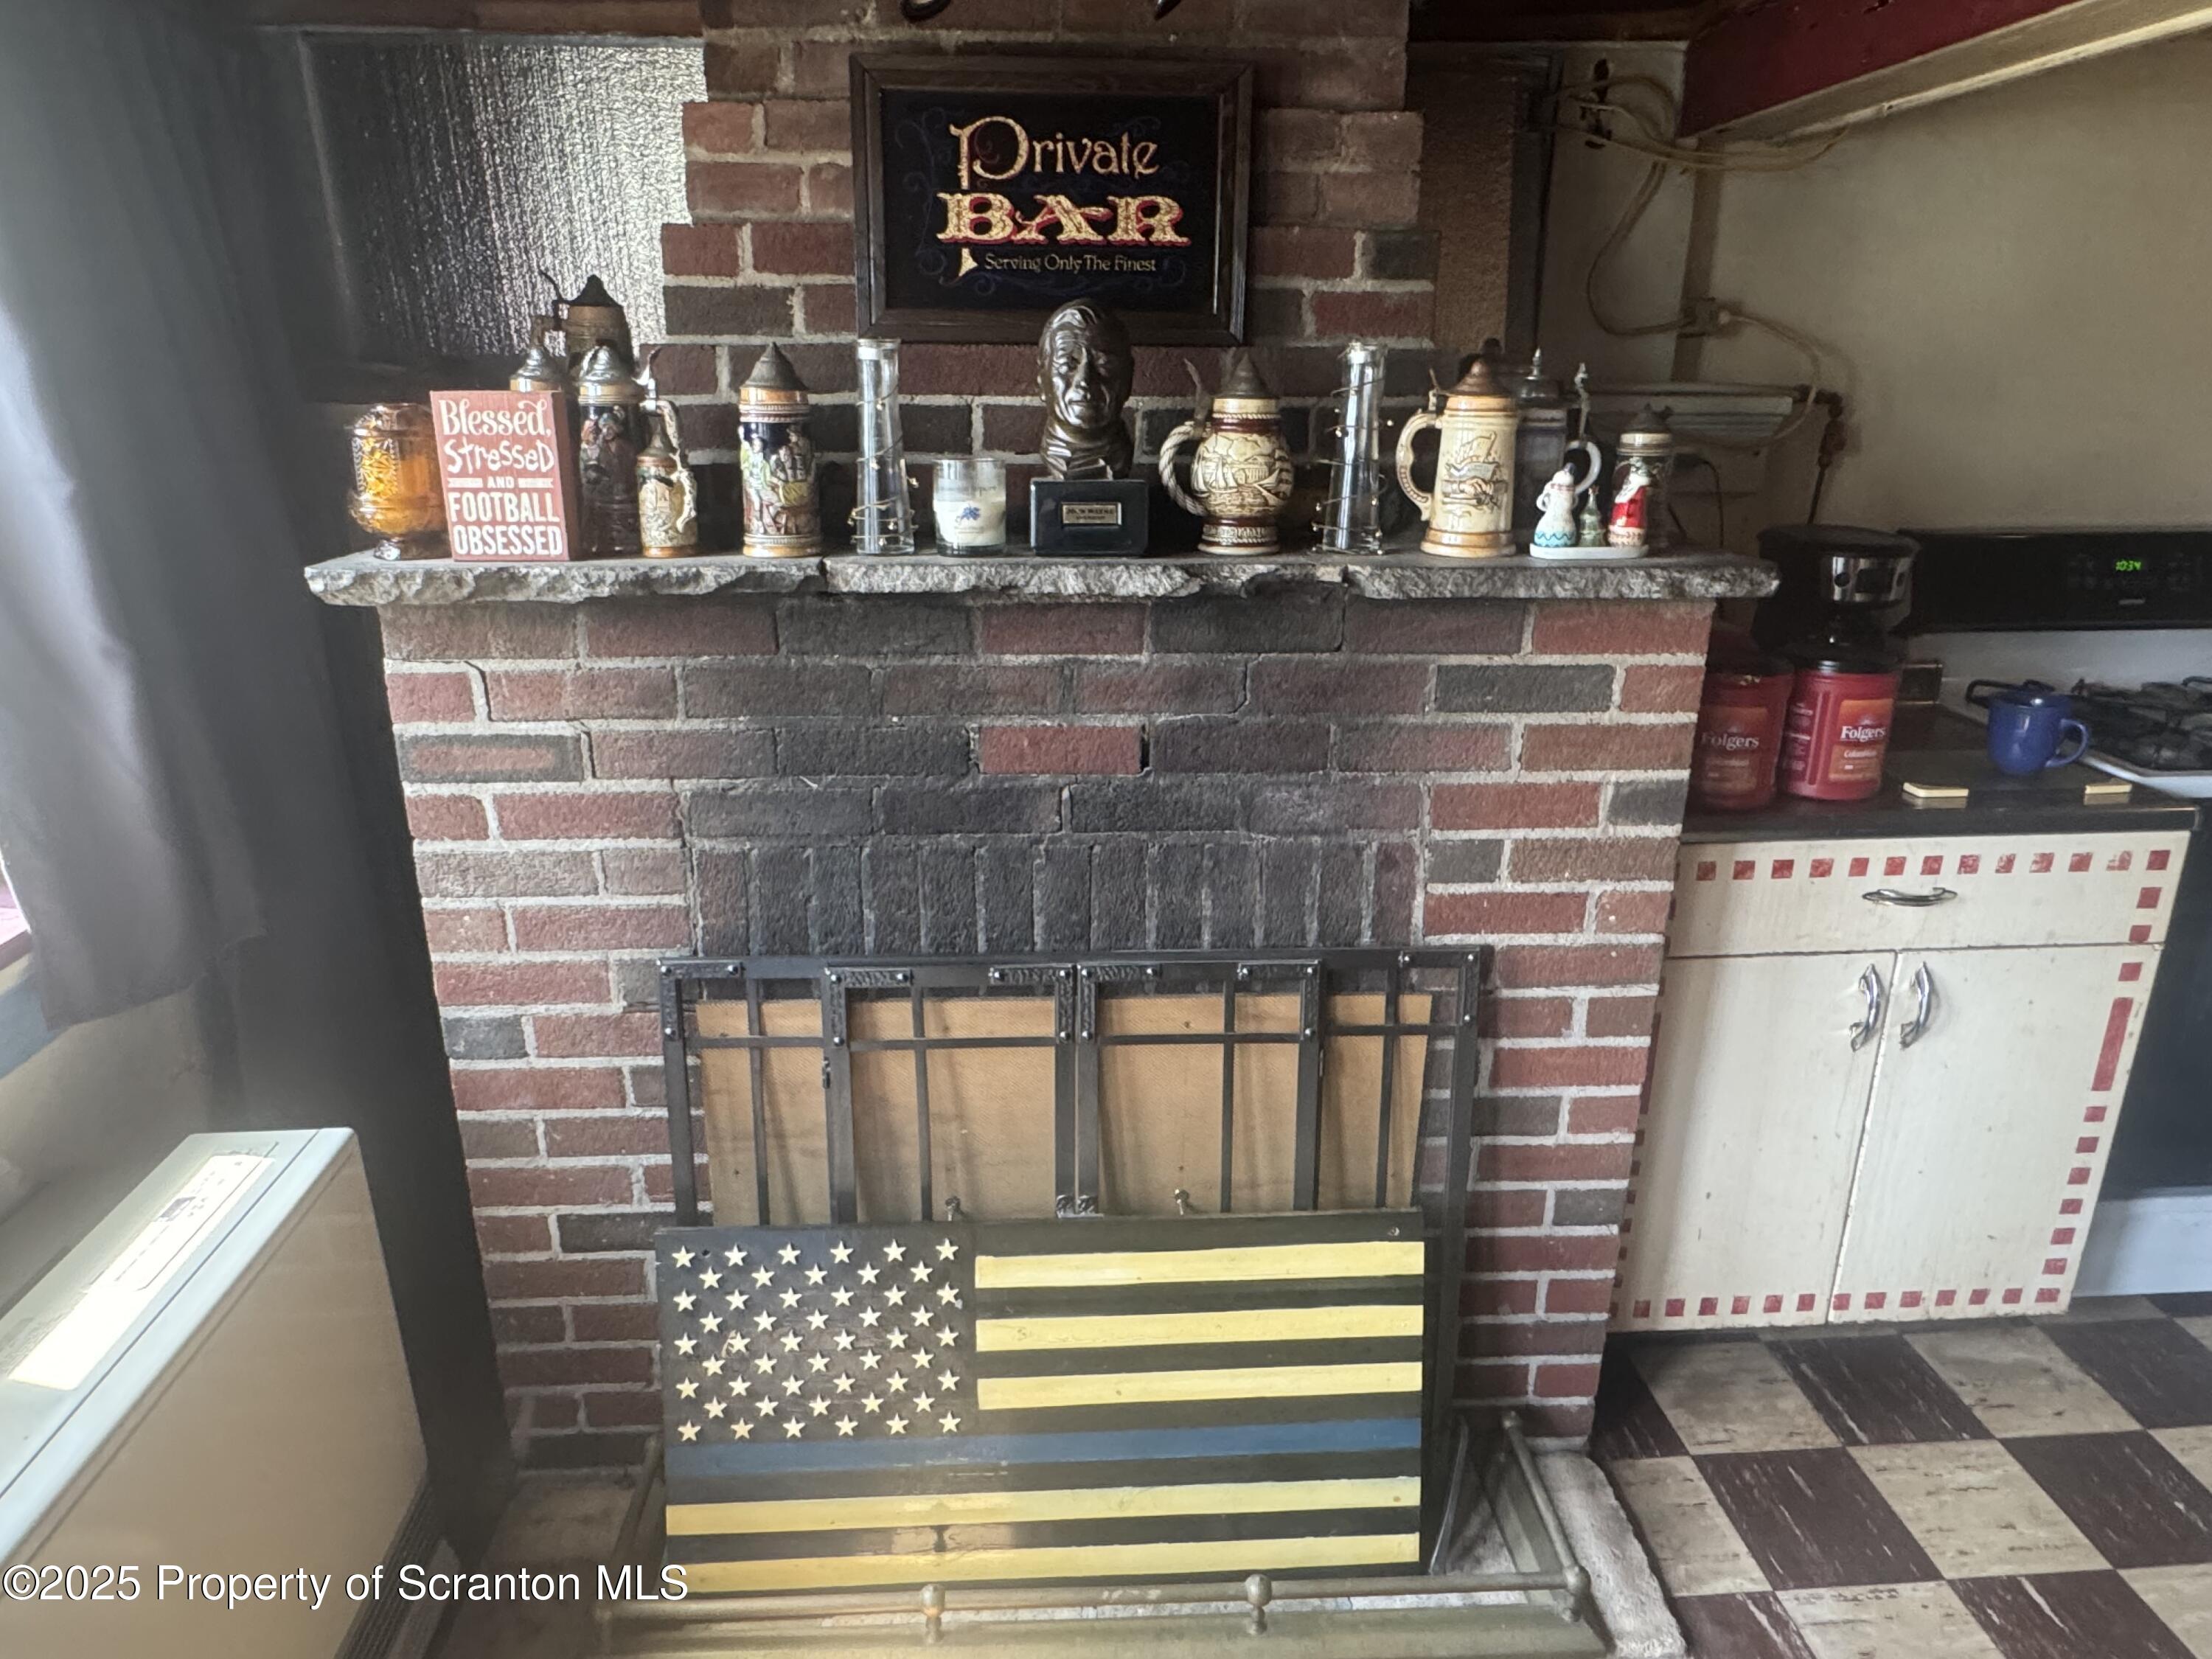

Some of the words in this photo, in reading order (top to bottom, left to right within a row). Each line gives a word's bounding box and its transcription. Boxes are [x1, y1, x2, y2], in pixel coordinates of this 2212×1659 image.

[949, 116, 1161, 190] Private
[936, 192, 1192, 246] BAR
[984, 252, 1041, 274] Serving
[1044, 253, 1082, 274] Only
[1084, 254, 1110, 271] The
[1114, 254, 1156, 271] Finest
[438, 398, 552, 437] Blessed,
[487, 476, 515, 488] AND
[448, 492, 560, 522] FOOTBALL
[453, 525, 563, 555] OBSESSED
[1701, 731, 1759, 751] Folgers
[1840, 725, 1886, 742] Folgers
